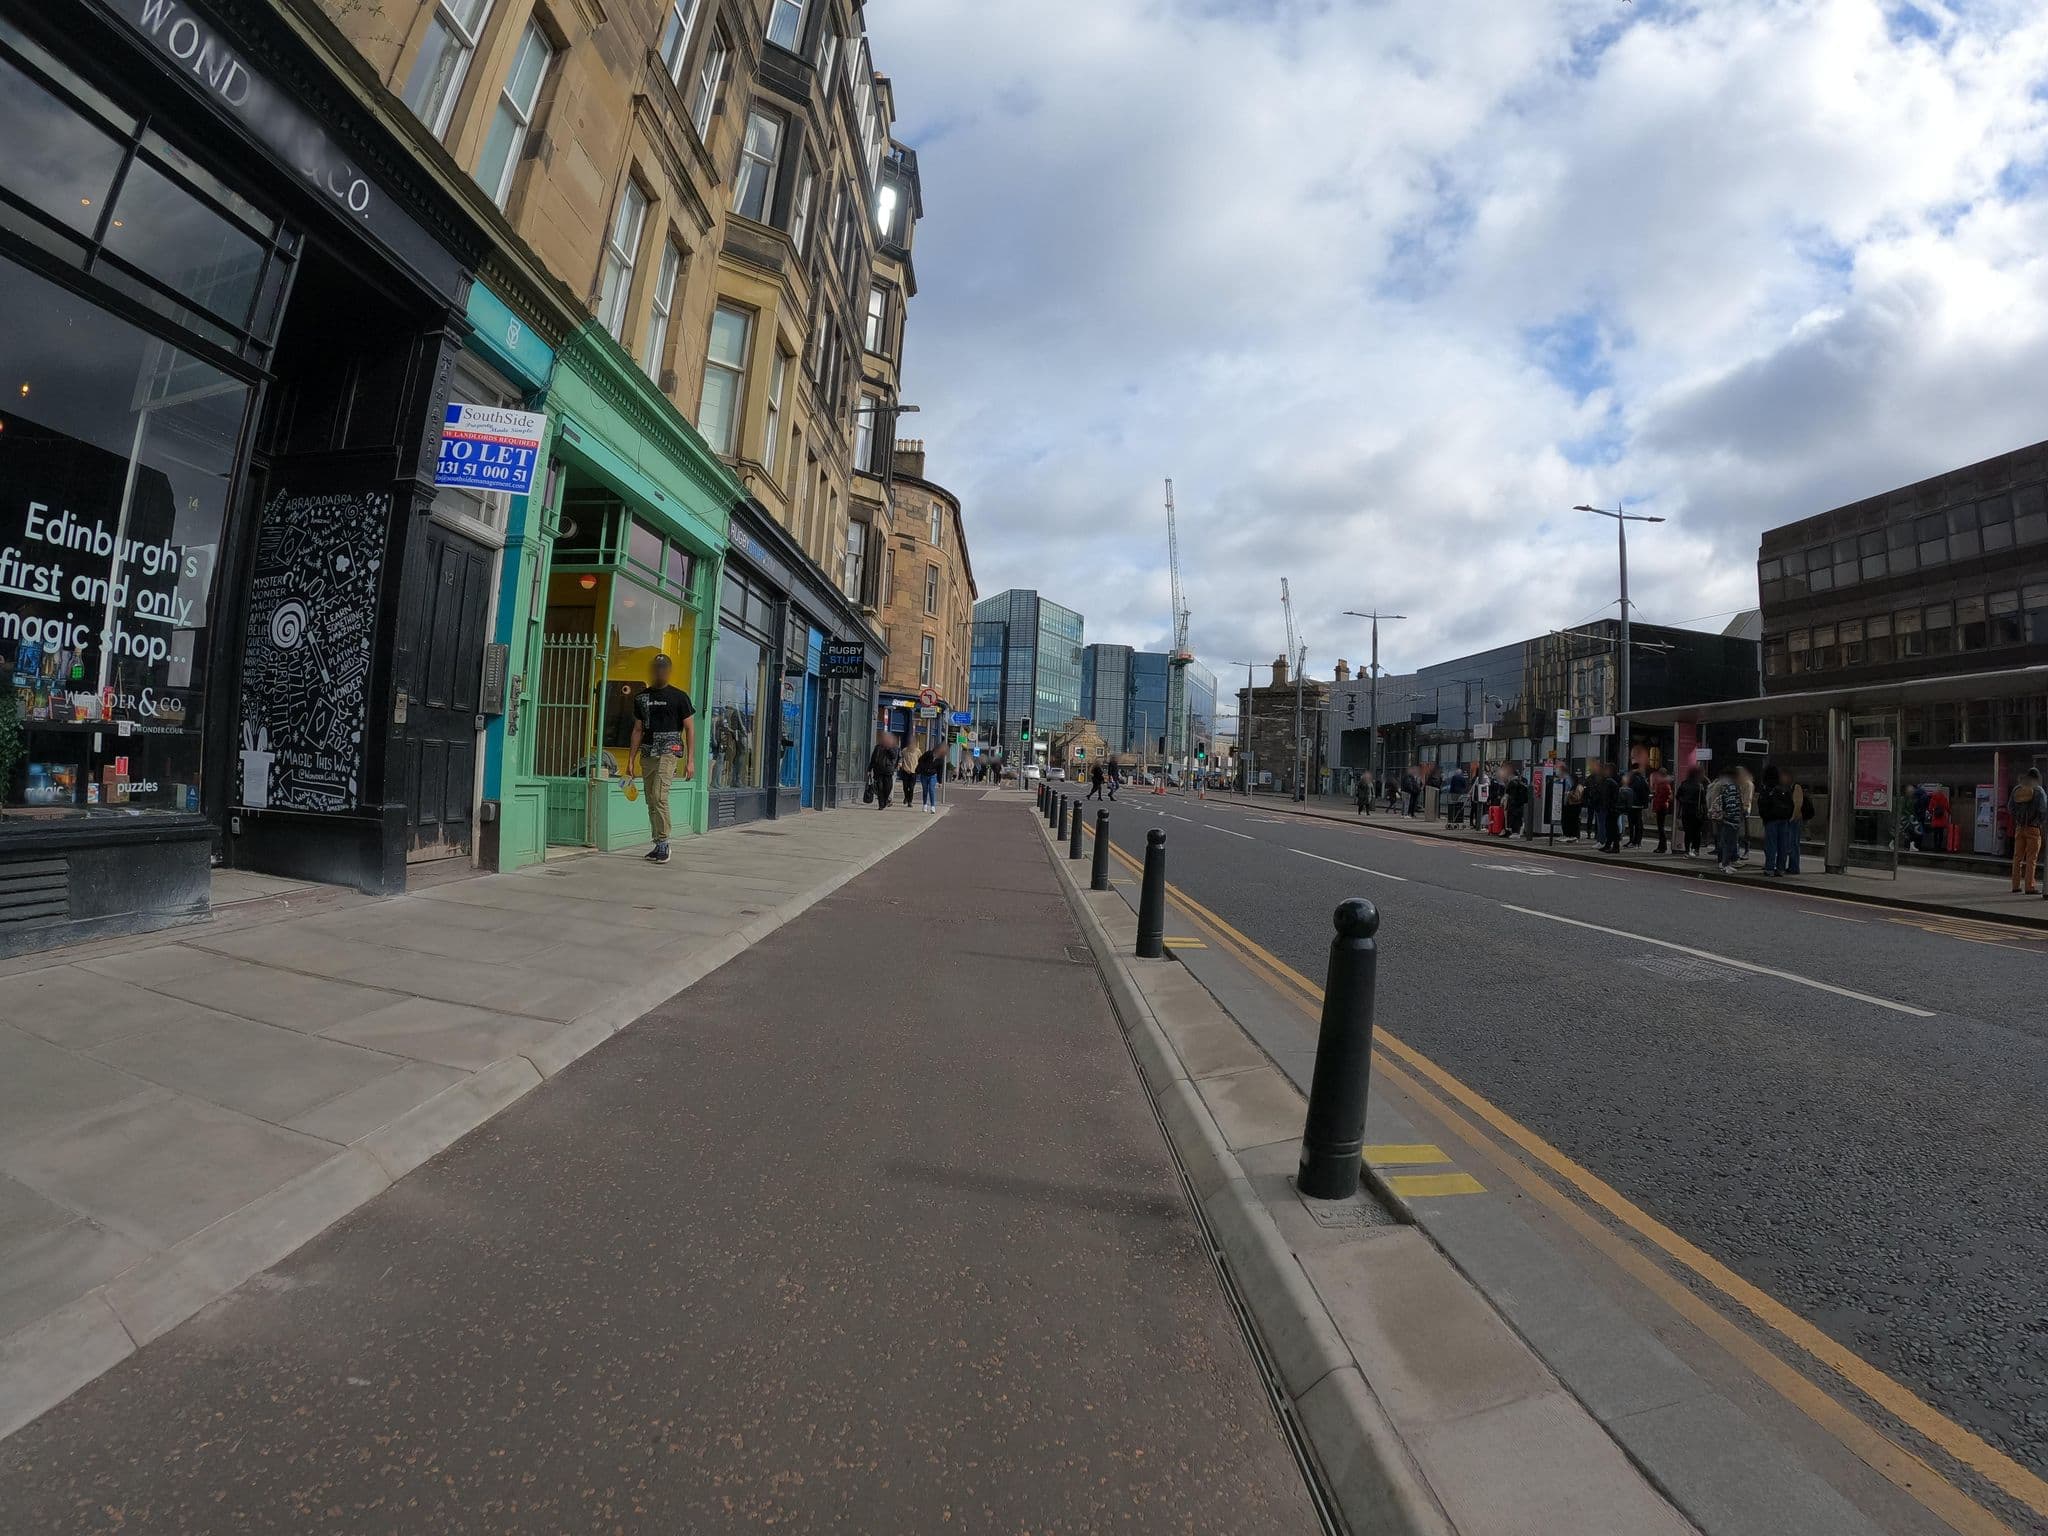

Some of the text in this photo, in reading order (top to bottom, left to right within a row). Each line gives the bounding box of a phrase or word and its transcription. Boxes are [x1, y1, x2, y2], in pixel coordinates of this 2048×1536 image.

[463, 407, 535, 428] SouthSide
[455, 432, 498, 442] LANDLORDS
[499, 436, 537, 447] REQUIRED
[439, 440, 473, 460] TO
[479, 443, 533, 468] LET
[463, 463, 478, 476] 51
[483, 466, 510, 480] 000
[512, 469, 527, 483] 51
[285, 494, 352, 512] ABRACADABRA
[25, 501, 198, 577] Edinburgh's
[0, 546, 193, 627] first and only
[252, 588, 287, 600] WONDER
[324, 604, 353, 625] LEARN
[326, 608, 364, 634] SOMETHING
[0, 610, 90, 654] magic
[328, 643, 360, 668] PLAYING
[829, 646, 863, 656] RUGBY
[830, 655, 864, 665] STUFF
[253, 646, 271, 692] BOOKS
[263, 651, 279, 695] GIFTS
[300, 645, 320, 699] MAGIC
[336, 655, 360, 676] CARDS
[65, 687, 186, 717] WONDER & CO.
[272, 652, 291, 748] CURIOSITIES
[288, 651, 309, 727] PUZZLES
[328, 676, 364, 703] WONDER
[327, 732, 354, 762] 2023
[283, 749, 352, 774] MAGIC THIS WAY
[117, 779, 159, 796] puzzles
